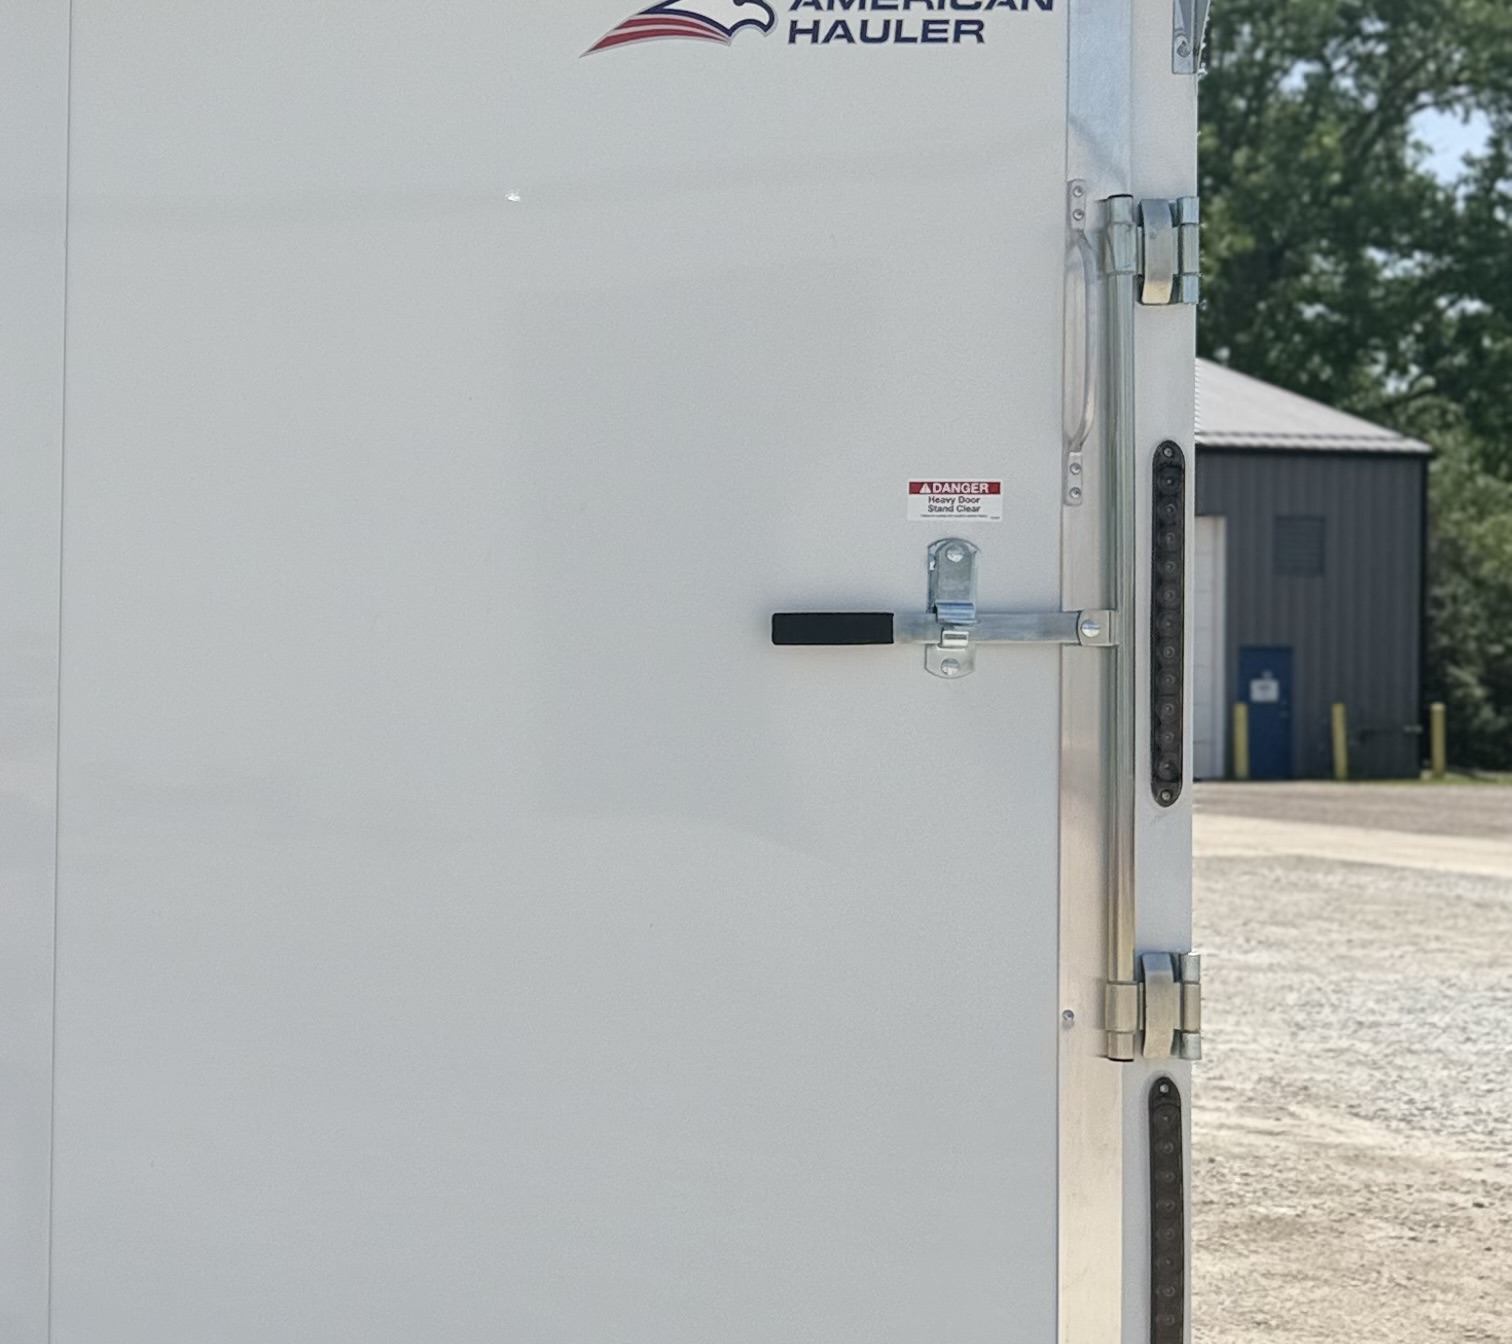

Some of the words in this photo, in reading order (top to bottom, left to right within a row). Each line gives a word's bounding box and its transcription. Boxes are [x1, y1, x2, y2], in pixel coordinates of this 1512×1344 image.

[788, 19, 985, 45] HAULER
[932, 482, 989, 494] DANGER
[928, 496, 956, 505] Heavy
[958, 496, 981, 504] Door
[927, 504, 954, 513] Stand
[956, 504, 981, 513] Clear
